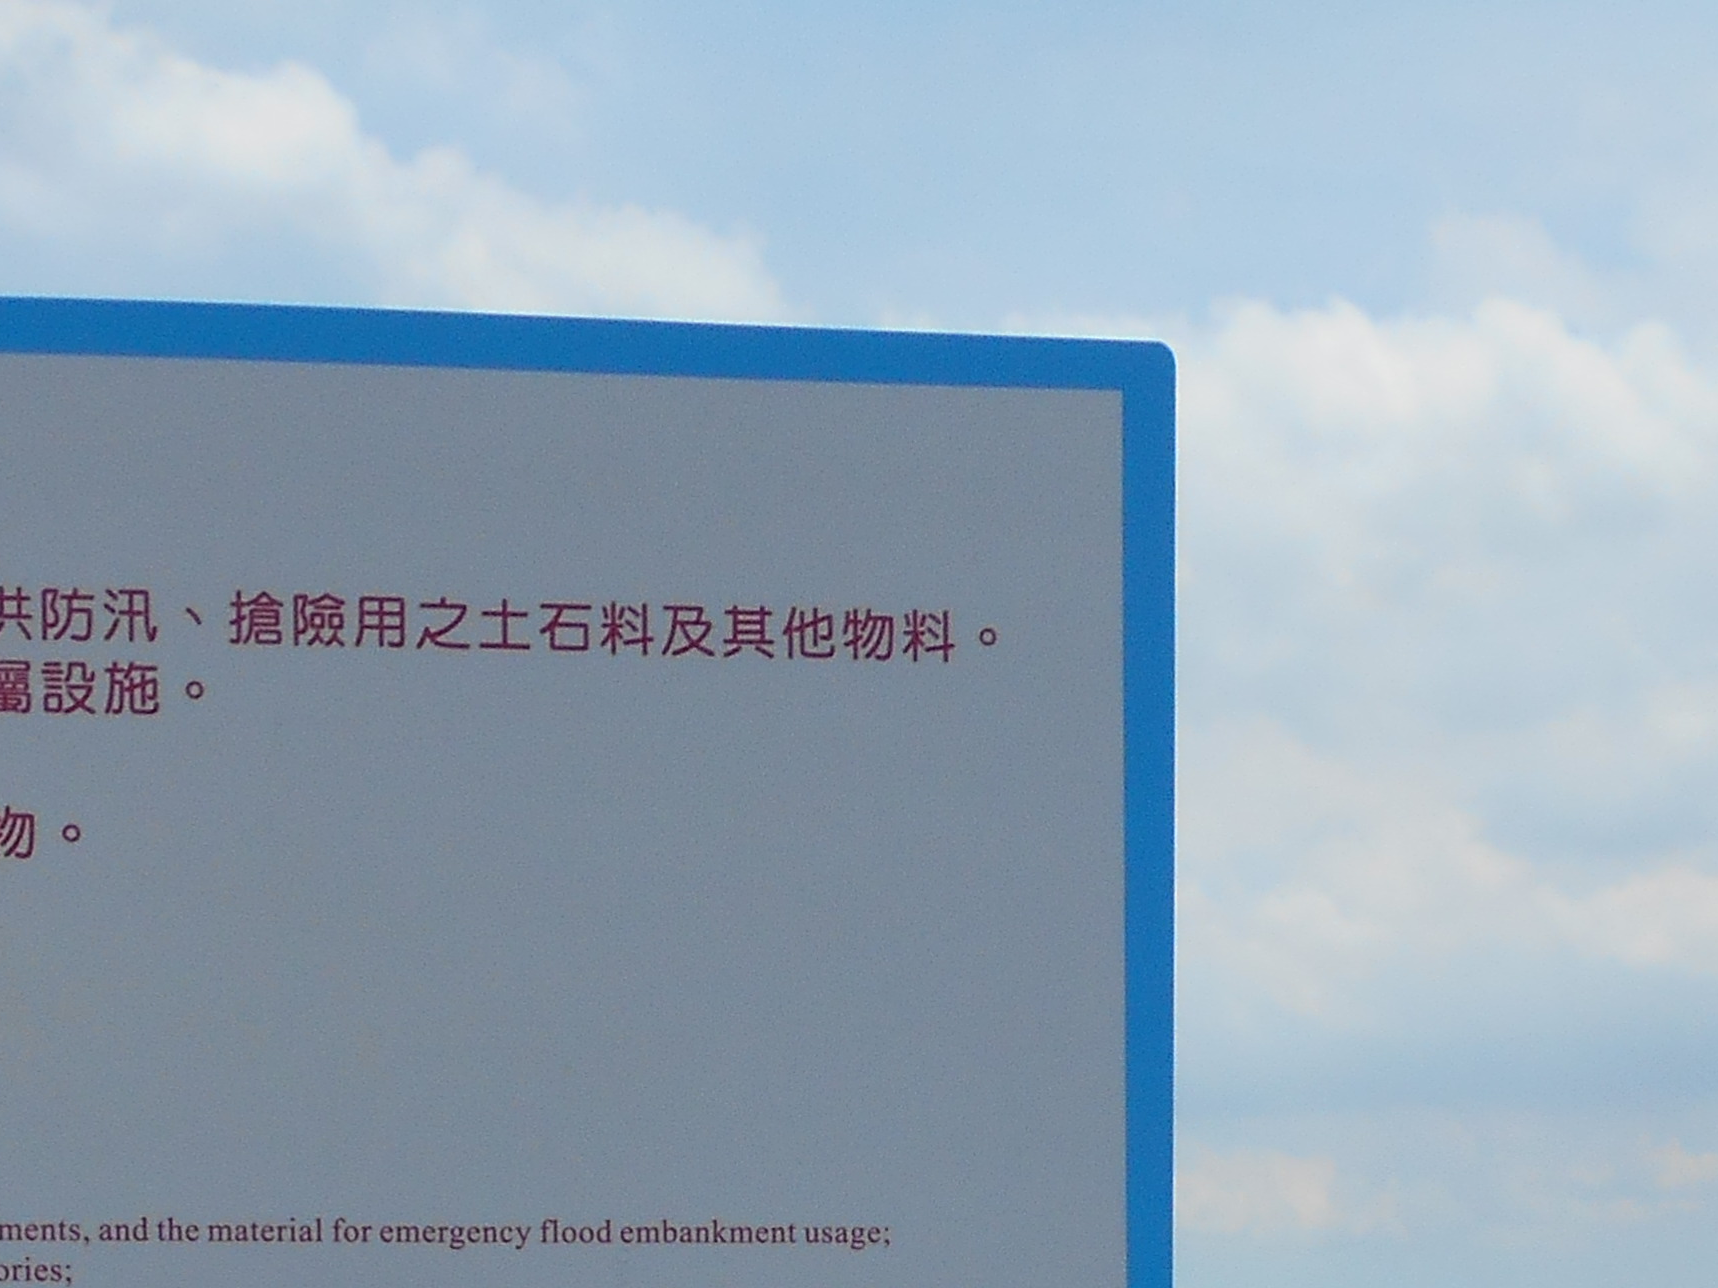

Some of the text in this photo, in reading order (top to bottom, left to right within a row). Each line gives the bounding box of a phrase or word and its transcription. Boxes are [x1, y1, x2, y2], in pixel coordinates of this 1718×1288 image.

[98, 1216, 150, 1242] and
[156, 1216, 200, 1243] the
[207, 1216, 324, 1243] material
[331, 1216, 374, 1244] for
[378, 1224, 532, 1251] emergency
[539, 1218, 613, 1245] flood
[619, 1218, 797, 1245] embankment
[802, 1225, 891, 1251] usage;
